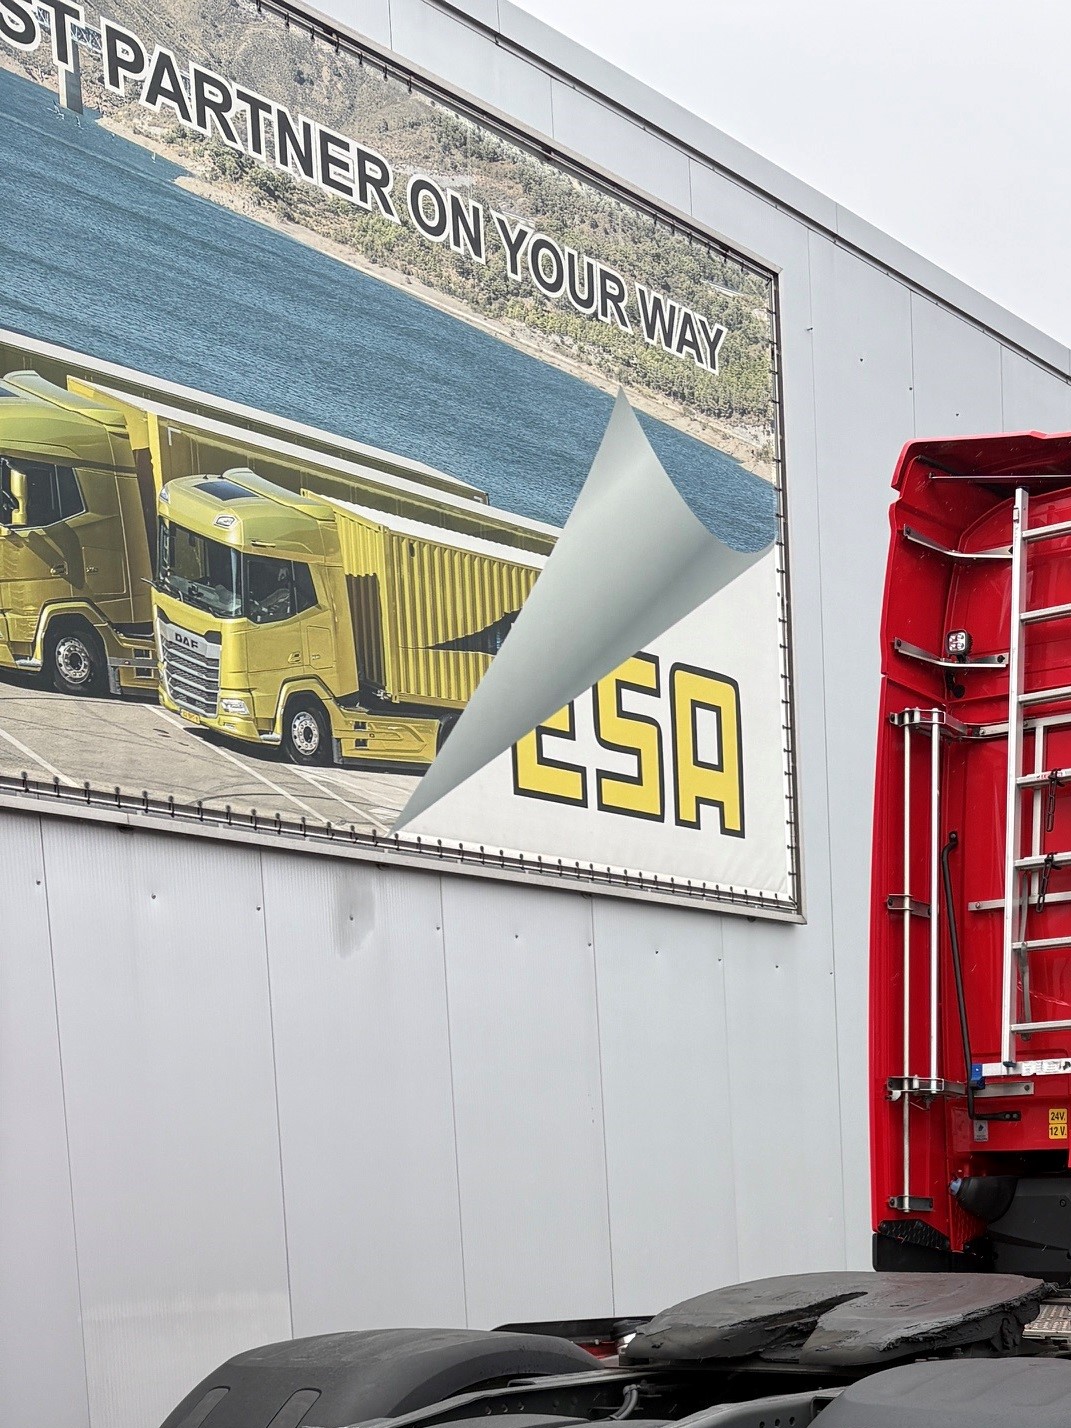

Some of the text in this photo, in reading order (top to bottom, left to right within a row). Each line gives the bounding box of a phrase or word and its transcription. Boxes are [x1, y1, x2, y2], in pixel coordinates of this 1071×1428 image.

[0, 0, 726, 371] ST PARTNER ON YOUR WAY
[174, 632, 199, 650] DAF
